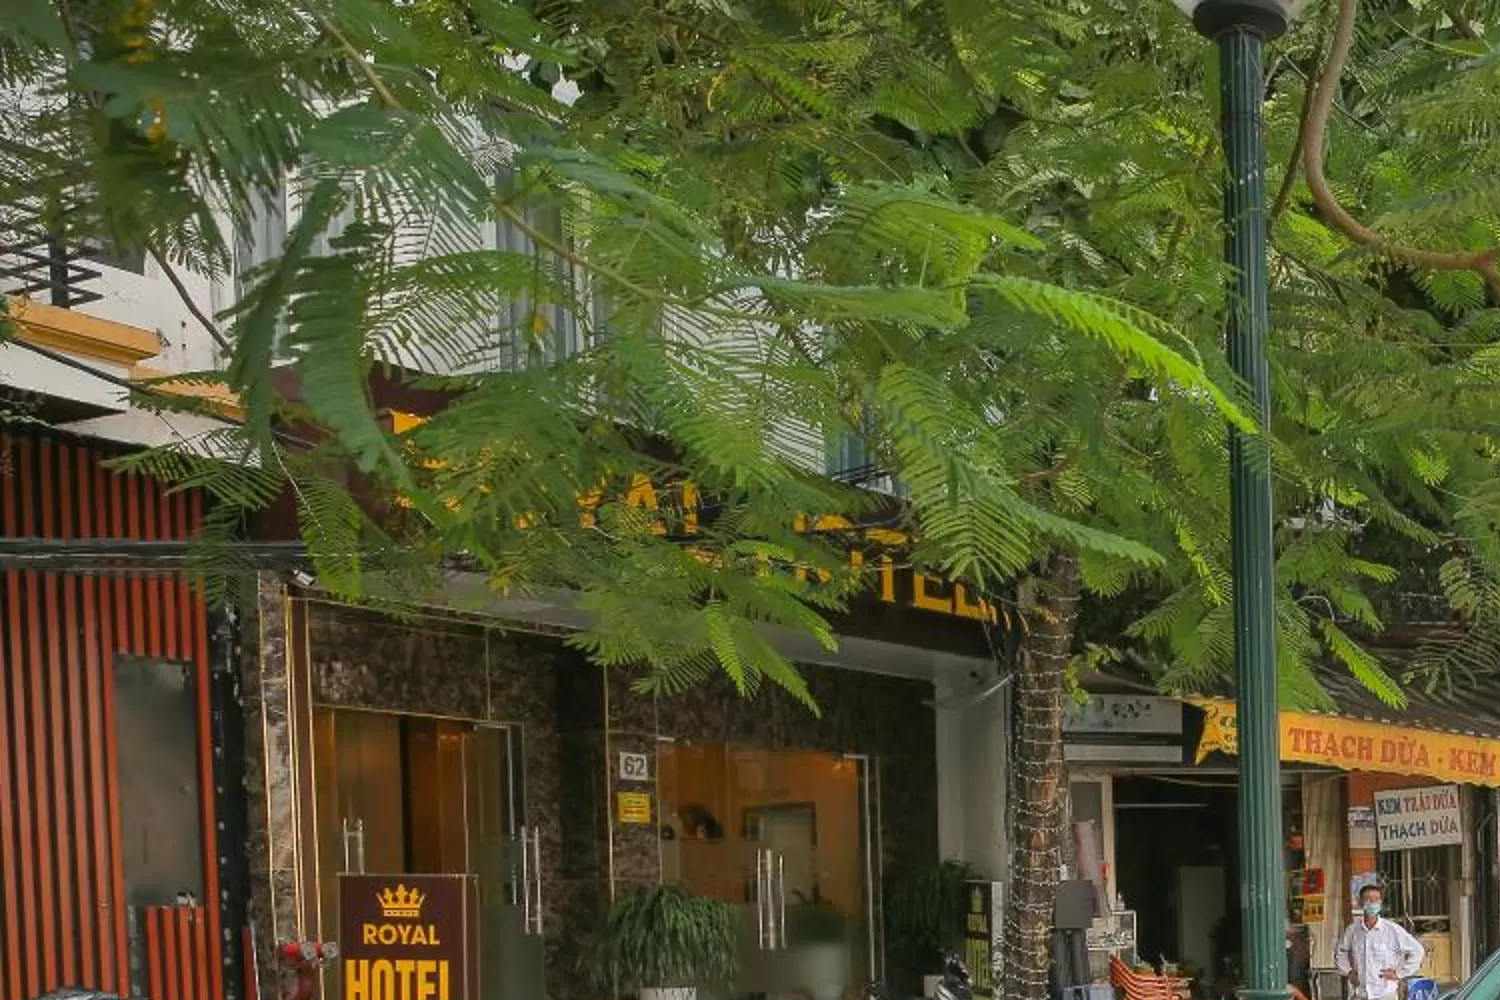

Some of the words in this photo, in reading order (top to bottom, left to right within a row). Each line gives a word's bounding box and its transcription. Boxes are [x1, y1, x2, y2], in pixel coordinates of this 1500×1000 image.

[1287, 727, 1374, 763] THẠCH
[1447, 747, 1497, 777] KEM
[624, 756, 645, 776] 62
[1380, 821, 1427, 842] THẠCH
[363, 923, 441, 945] ROYAL
